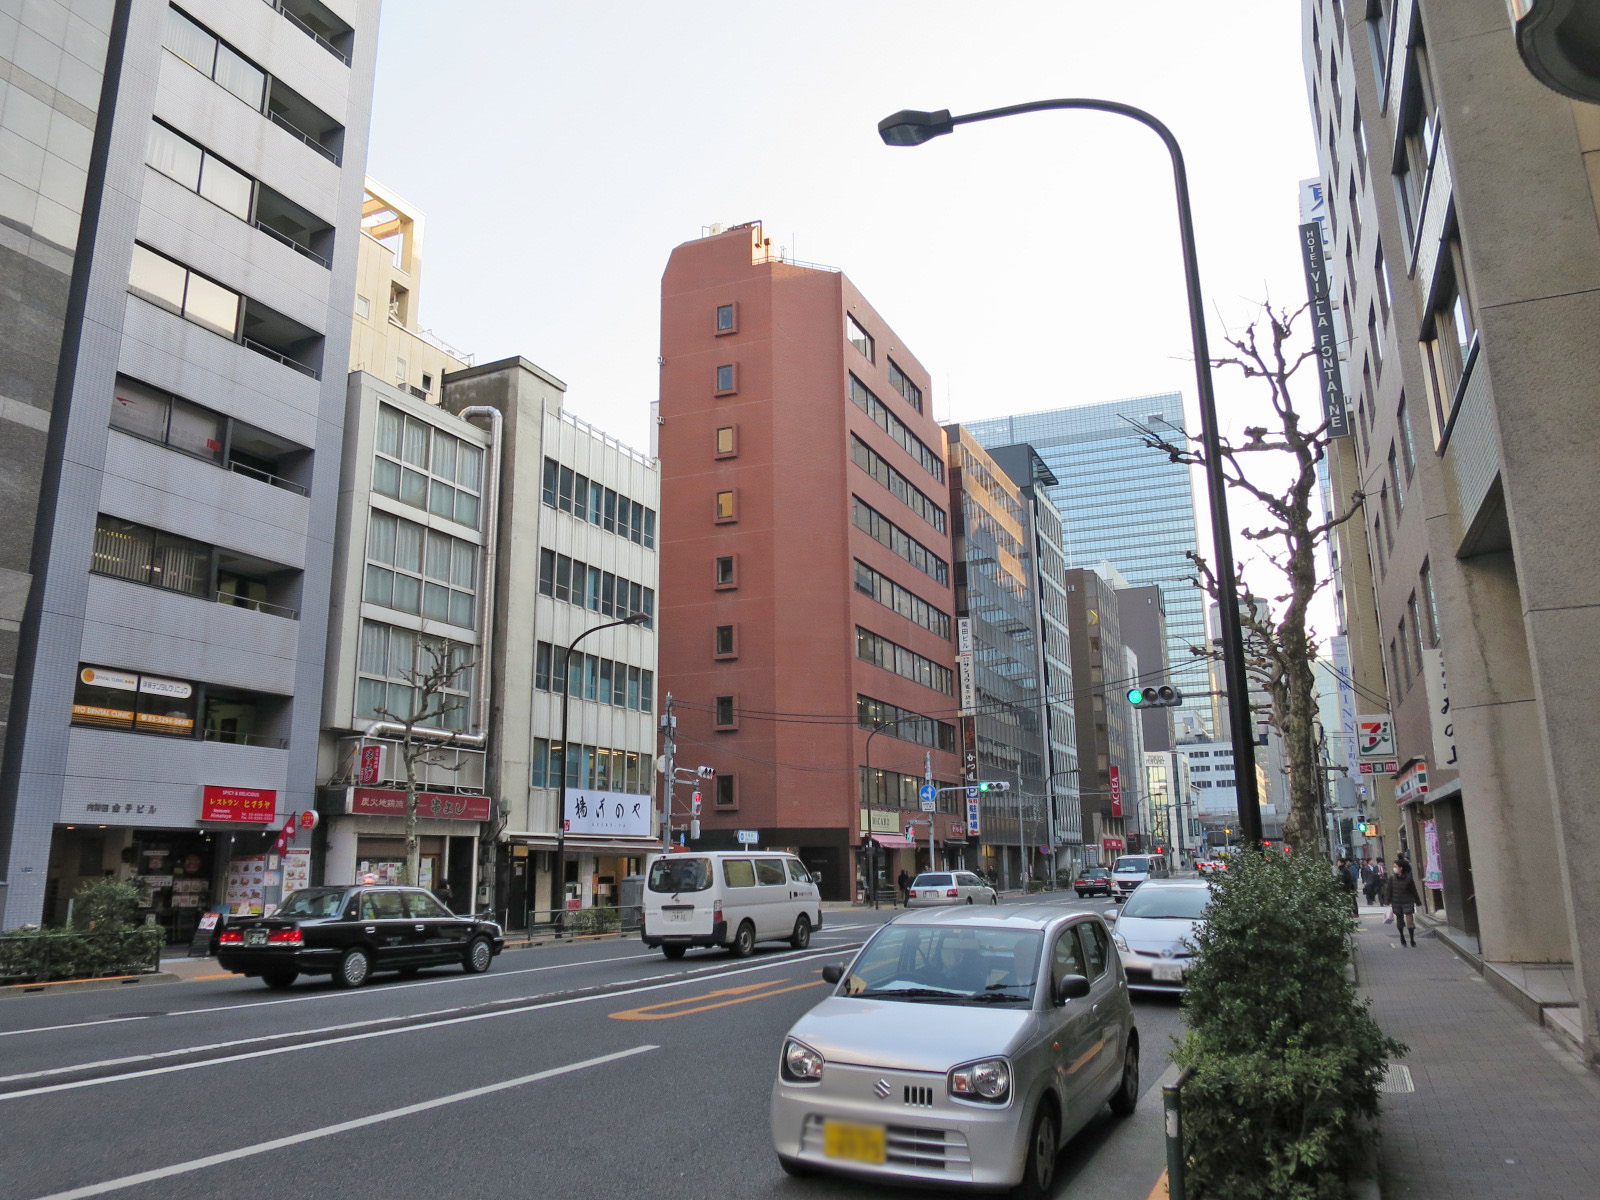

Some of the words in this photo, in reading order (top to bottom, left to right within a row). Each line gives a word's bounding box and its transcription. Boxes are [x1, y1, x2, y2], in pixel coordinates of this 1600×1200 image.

[1306, 231, 1317, 268] HOTEL
[1311, 272, 1328, 328] VILLA
[1320, 335, 1342, 428] FONTAINE
[75, 705, 85, 714] ITO
[87, 706, 110, 717] DENTAL
[111, 709, 131, 719] CLINIC
[1386, 762, 1397, 772] ATM
[210, 798, 239, 806] レストラン
[244, 800, 271, 809] ヒマラヤ
[1112, 777, 1120, 806] ACCEA
[431, 796, 467, 817] 串よし
[575, 796, 641, 819] 揚げのや
[969, 805, 978, 830] 駐車場
